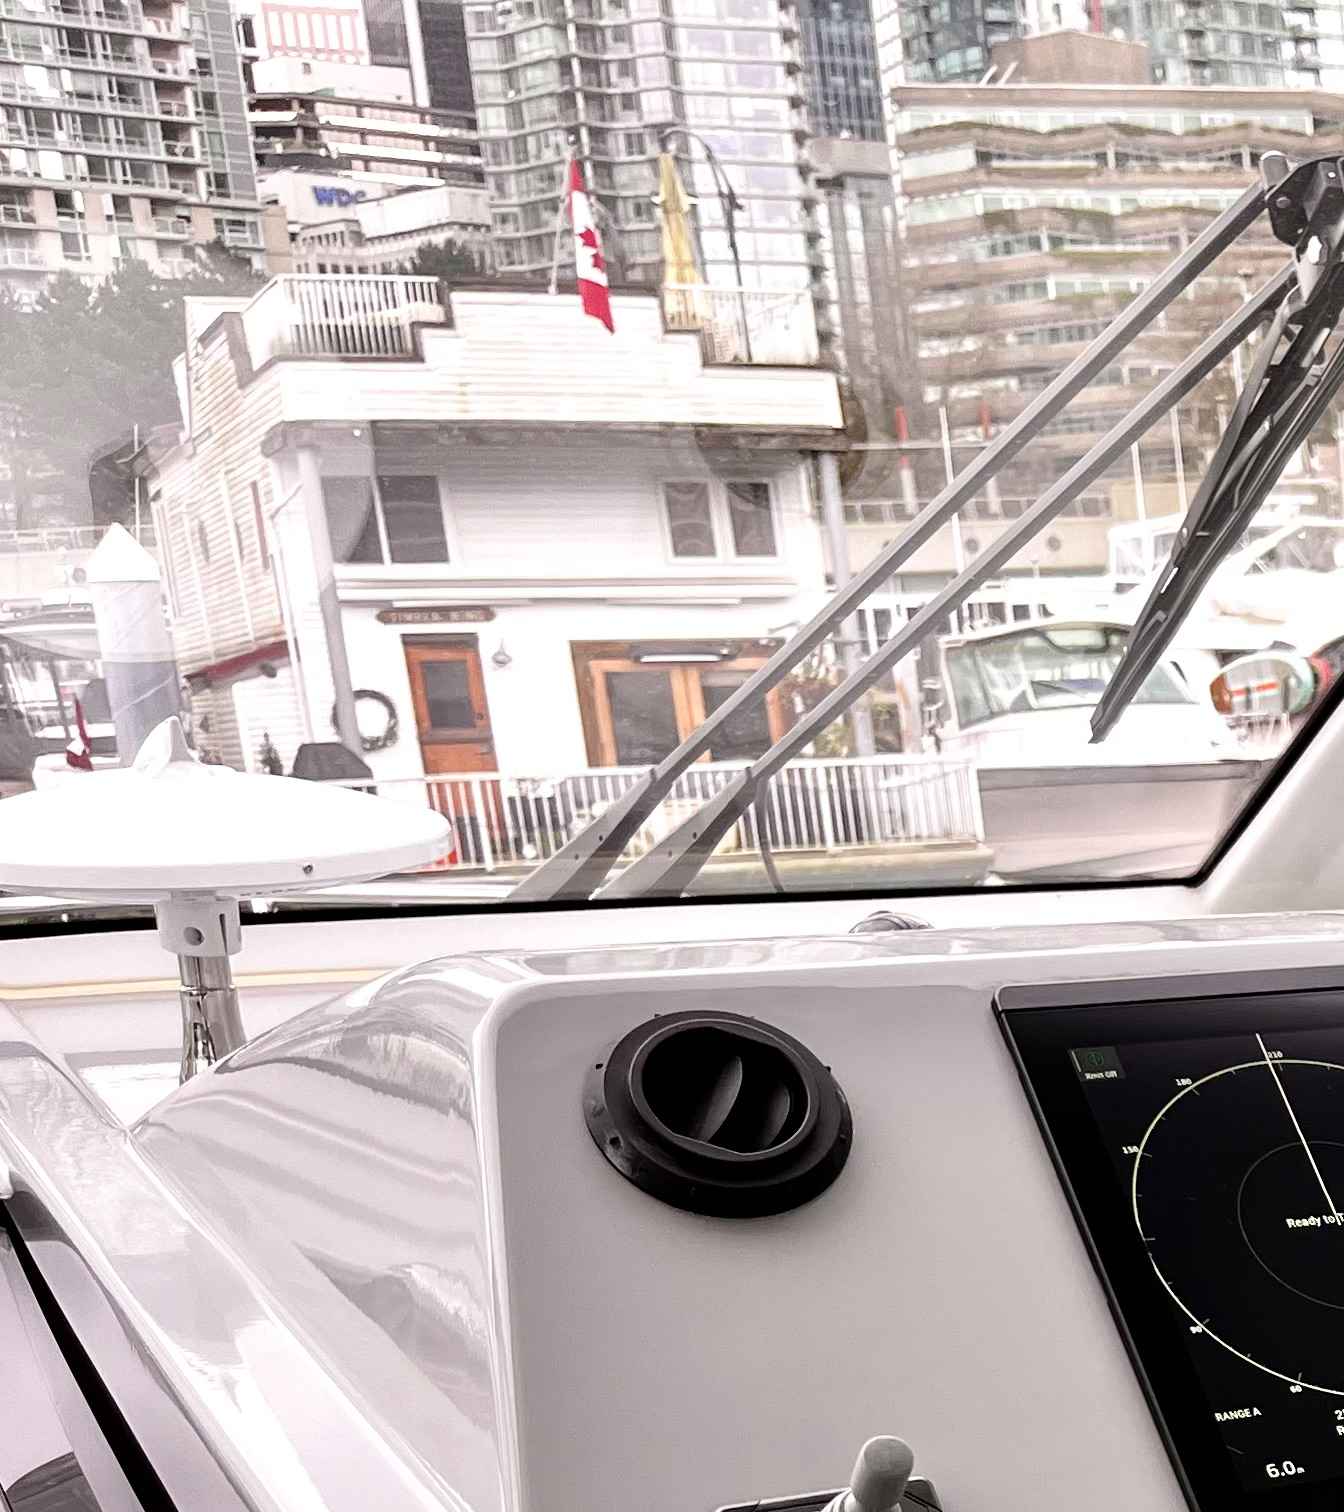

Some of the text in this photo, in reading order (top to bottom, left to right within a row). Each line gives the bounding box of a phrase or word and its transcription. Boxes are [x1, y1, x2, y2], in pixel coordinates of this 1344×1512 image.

[1175, 1078, 1192, 1087] 180
[1285, 1215, 1321, 1229] Ready
[1322, 1214, 1335, 1224] to
[1214, 1406, 1262, 1422] RANGE A
